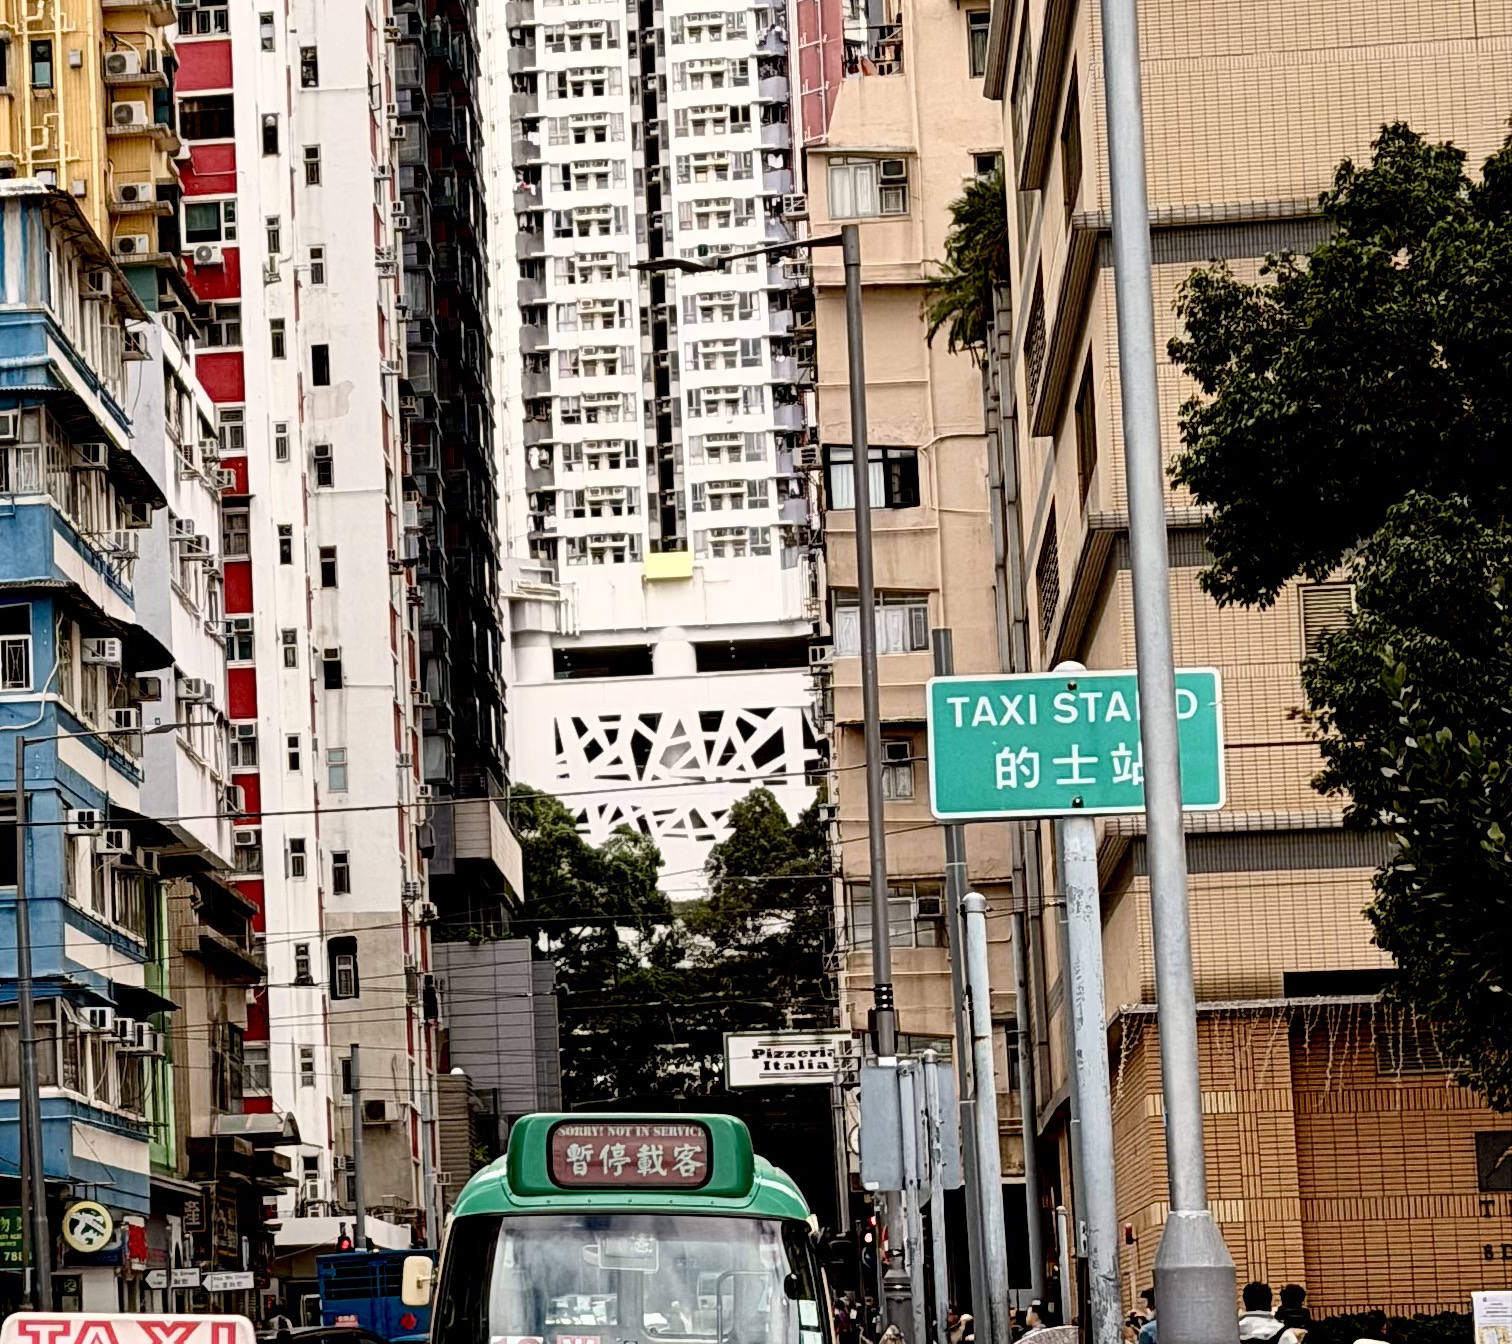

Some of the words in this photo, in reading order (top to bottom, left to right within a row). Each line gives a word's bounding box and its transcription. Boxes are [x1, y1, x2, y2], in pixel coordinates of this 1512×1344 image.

[946, 693, 1038, 728] TAXI
[1053, 688, 1198, 724] STAD
[763, 1059, 830, 1071] Italia
[558, 1126, 603, 1137] SORRY!
[608, 1126, 632, 1137] NOT
[637, 1126, 650, 1137] IN
[566, 1142, 705, 1178] 暫停載客
